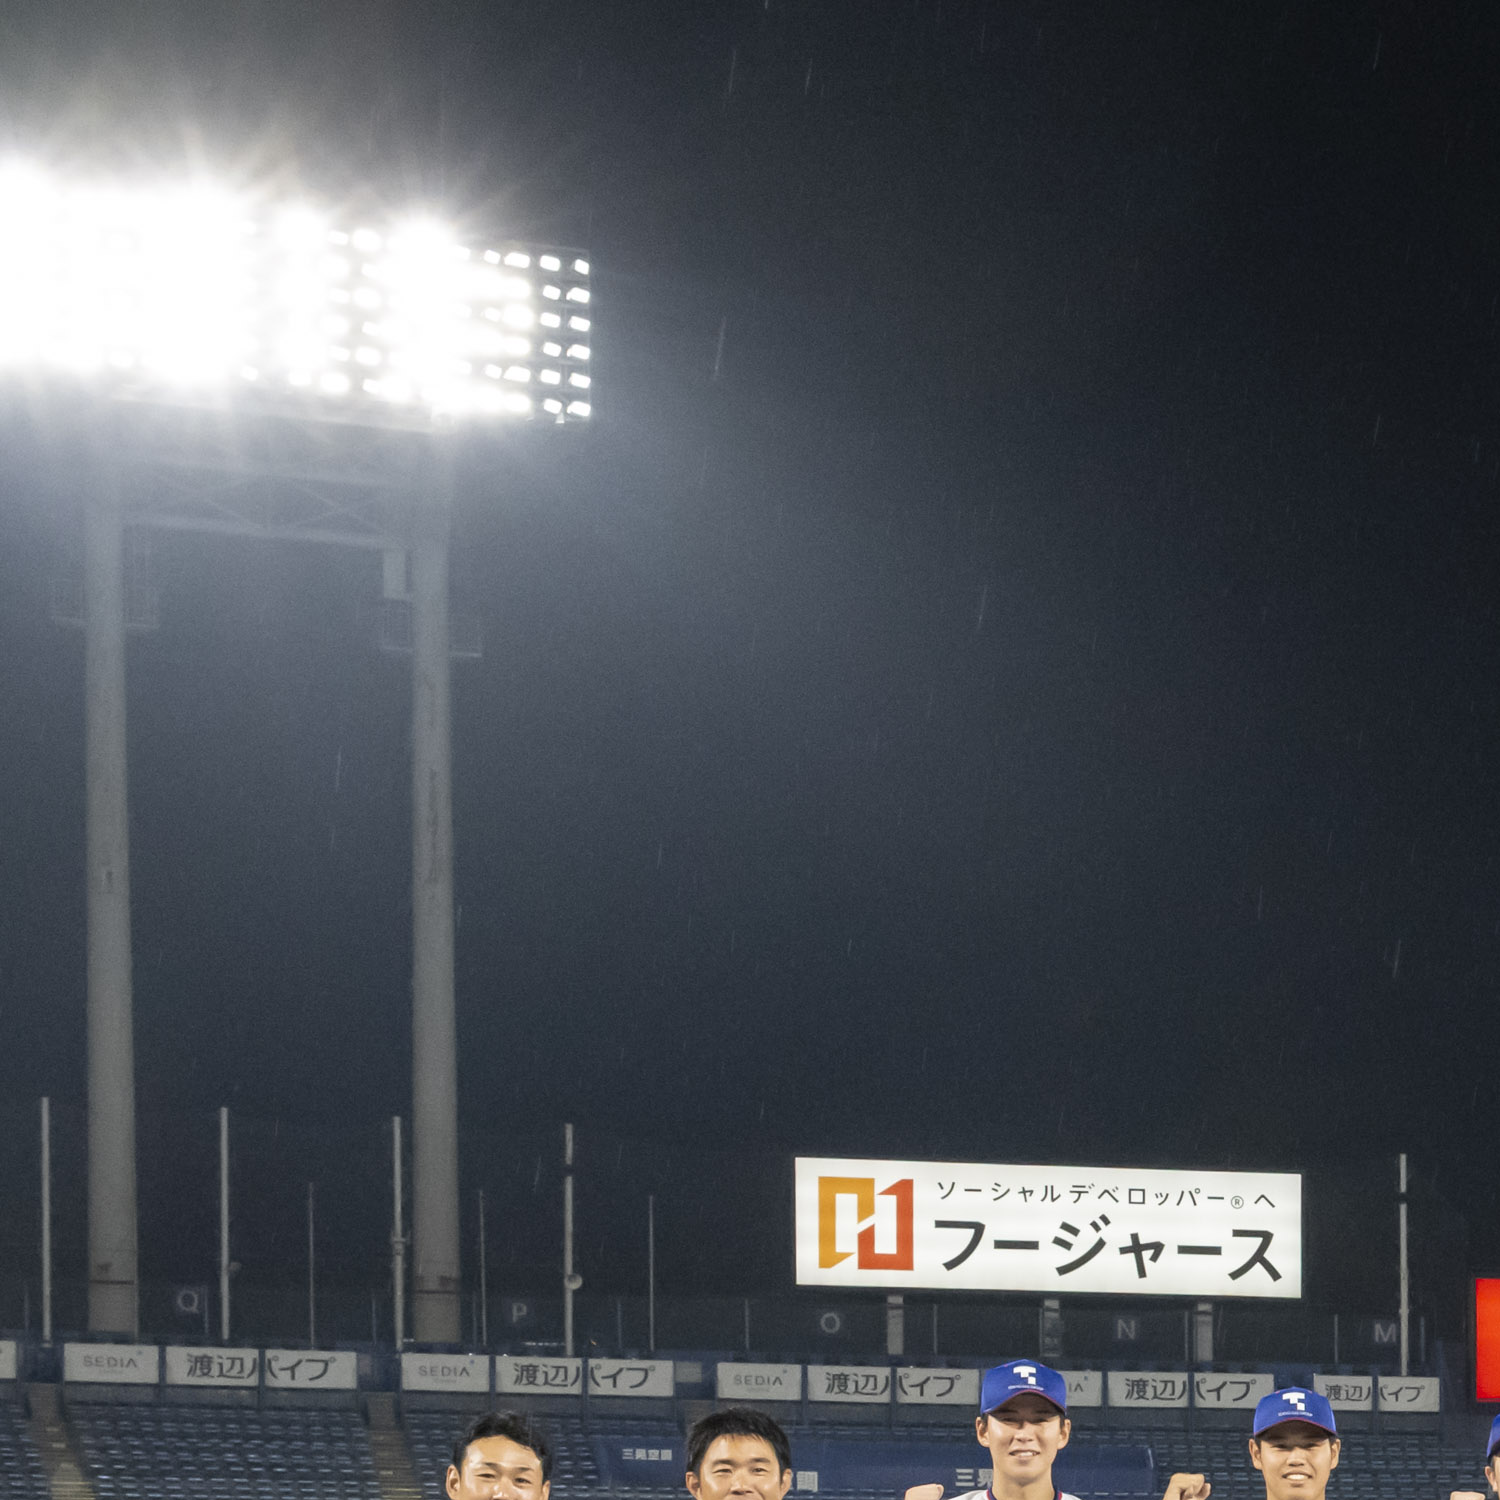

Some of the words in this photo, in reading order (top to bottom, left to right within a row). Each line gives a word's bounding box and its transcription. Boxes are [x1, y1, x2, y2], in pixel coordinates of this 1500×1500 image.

[933, 1212, 1283, 1283] フージャース
[186, 1355, 337, 1381] 渡辺パイプ
[513, 1362, 656, 1390] 渡辺パイプ
[825, 1372, 961, 1399] 渡辺パイプ
[1124, 1378, 1257, 1401] 渡辺パイプ
[1325, 1383, 1426, 1403] 渡辺パイプ
